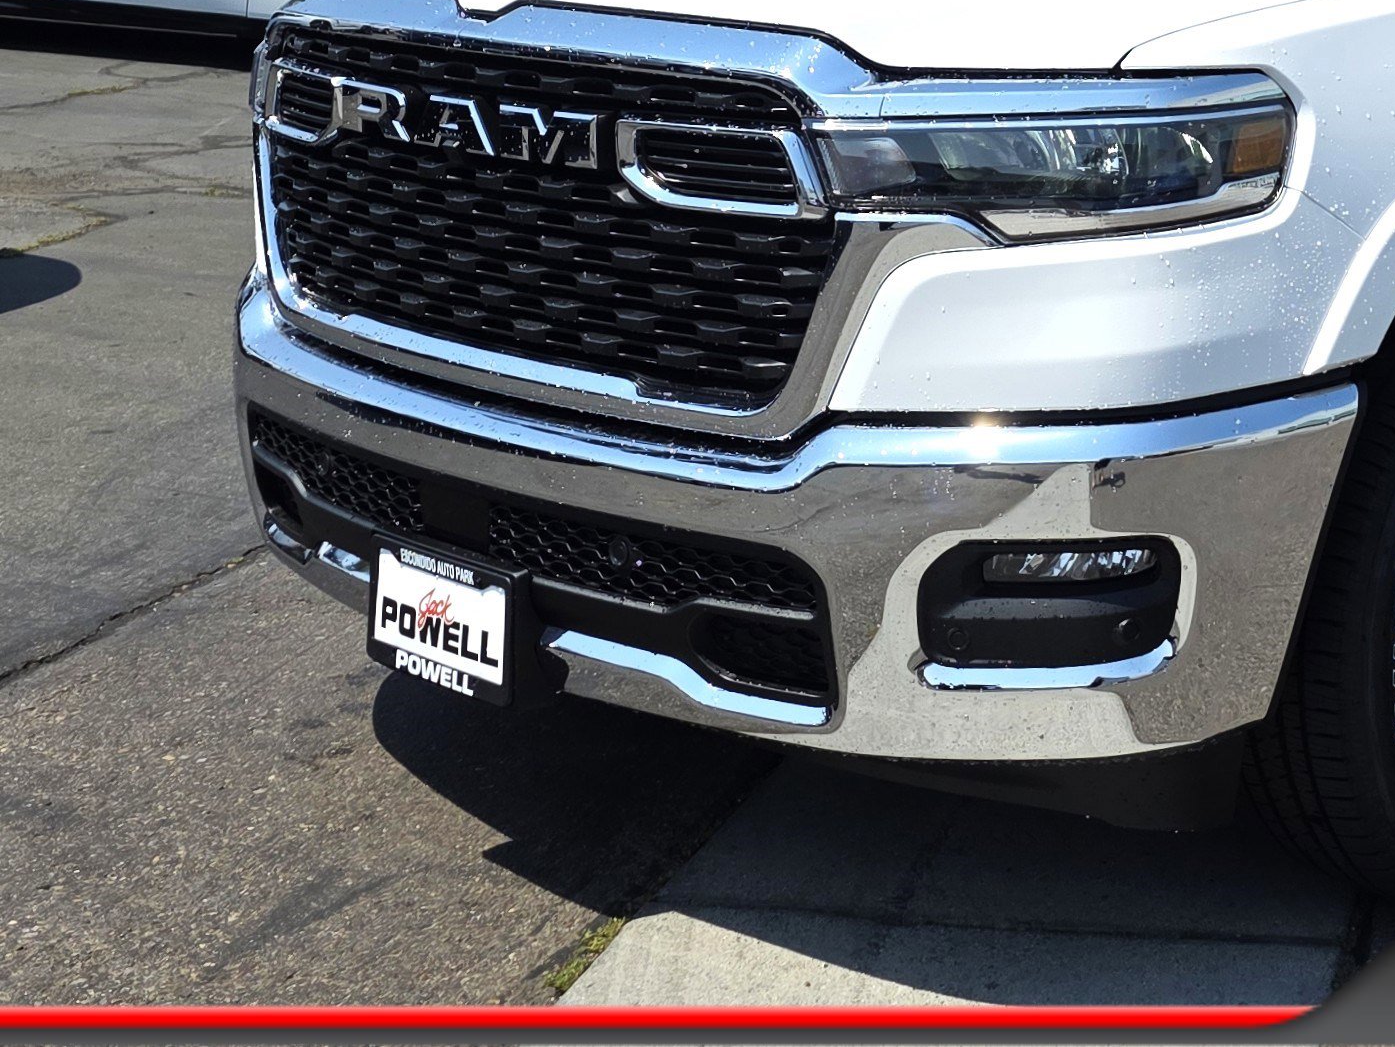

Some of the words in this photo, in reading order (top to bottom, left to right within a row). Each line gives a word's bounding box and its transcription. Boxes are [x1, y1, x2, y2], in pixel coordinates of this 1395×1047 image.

[335, 77, 599, 170] RAM
[400, 547, 437, 574] ESCONDIDO
[436, 559, 455, 578] AUTO
[455, 566, 475, 586] PARK
[381, 596, 499, 668] POWELL
[417, 587, 455, 631] Jack
[395, 648, 474, 697] POWELL
